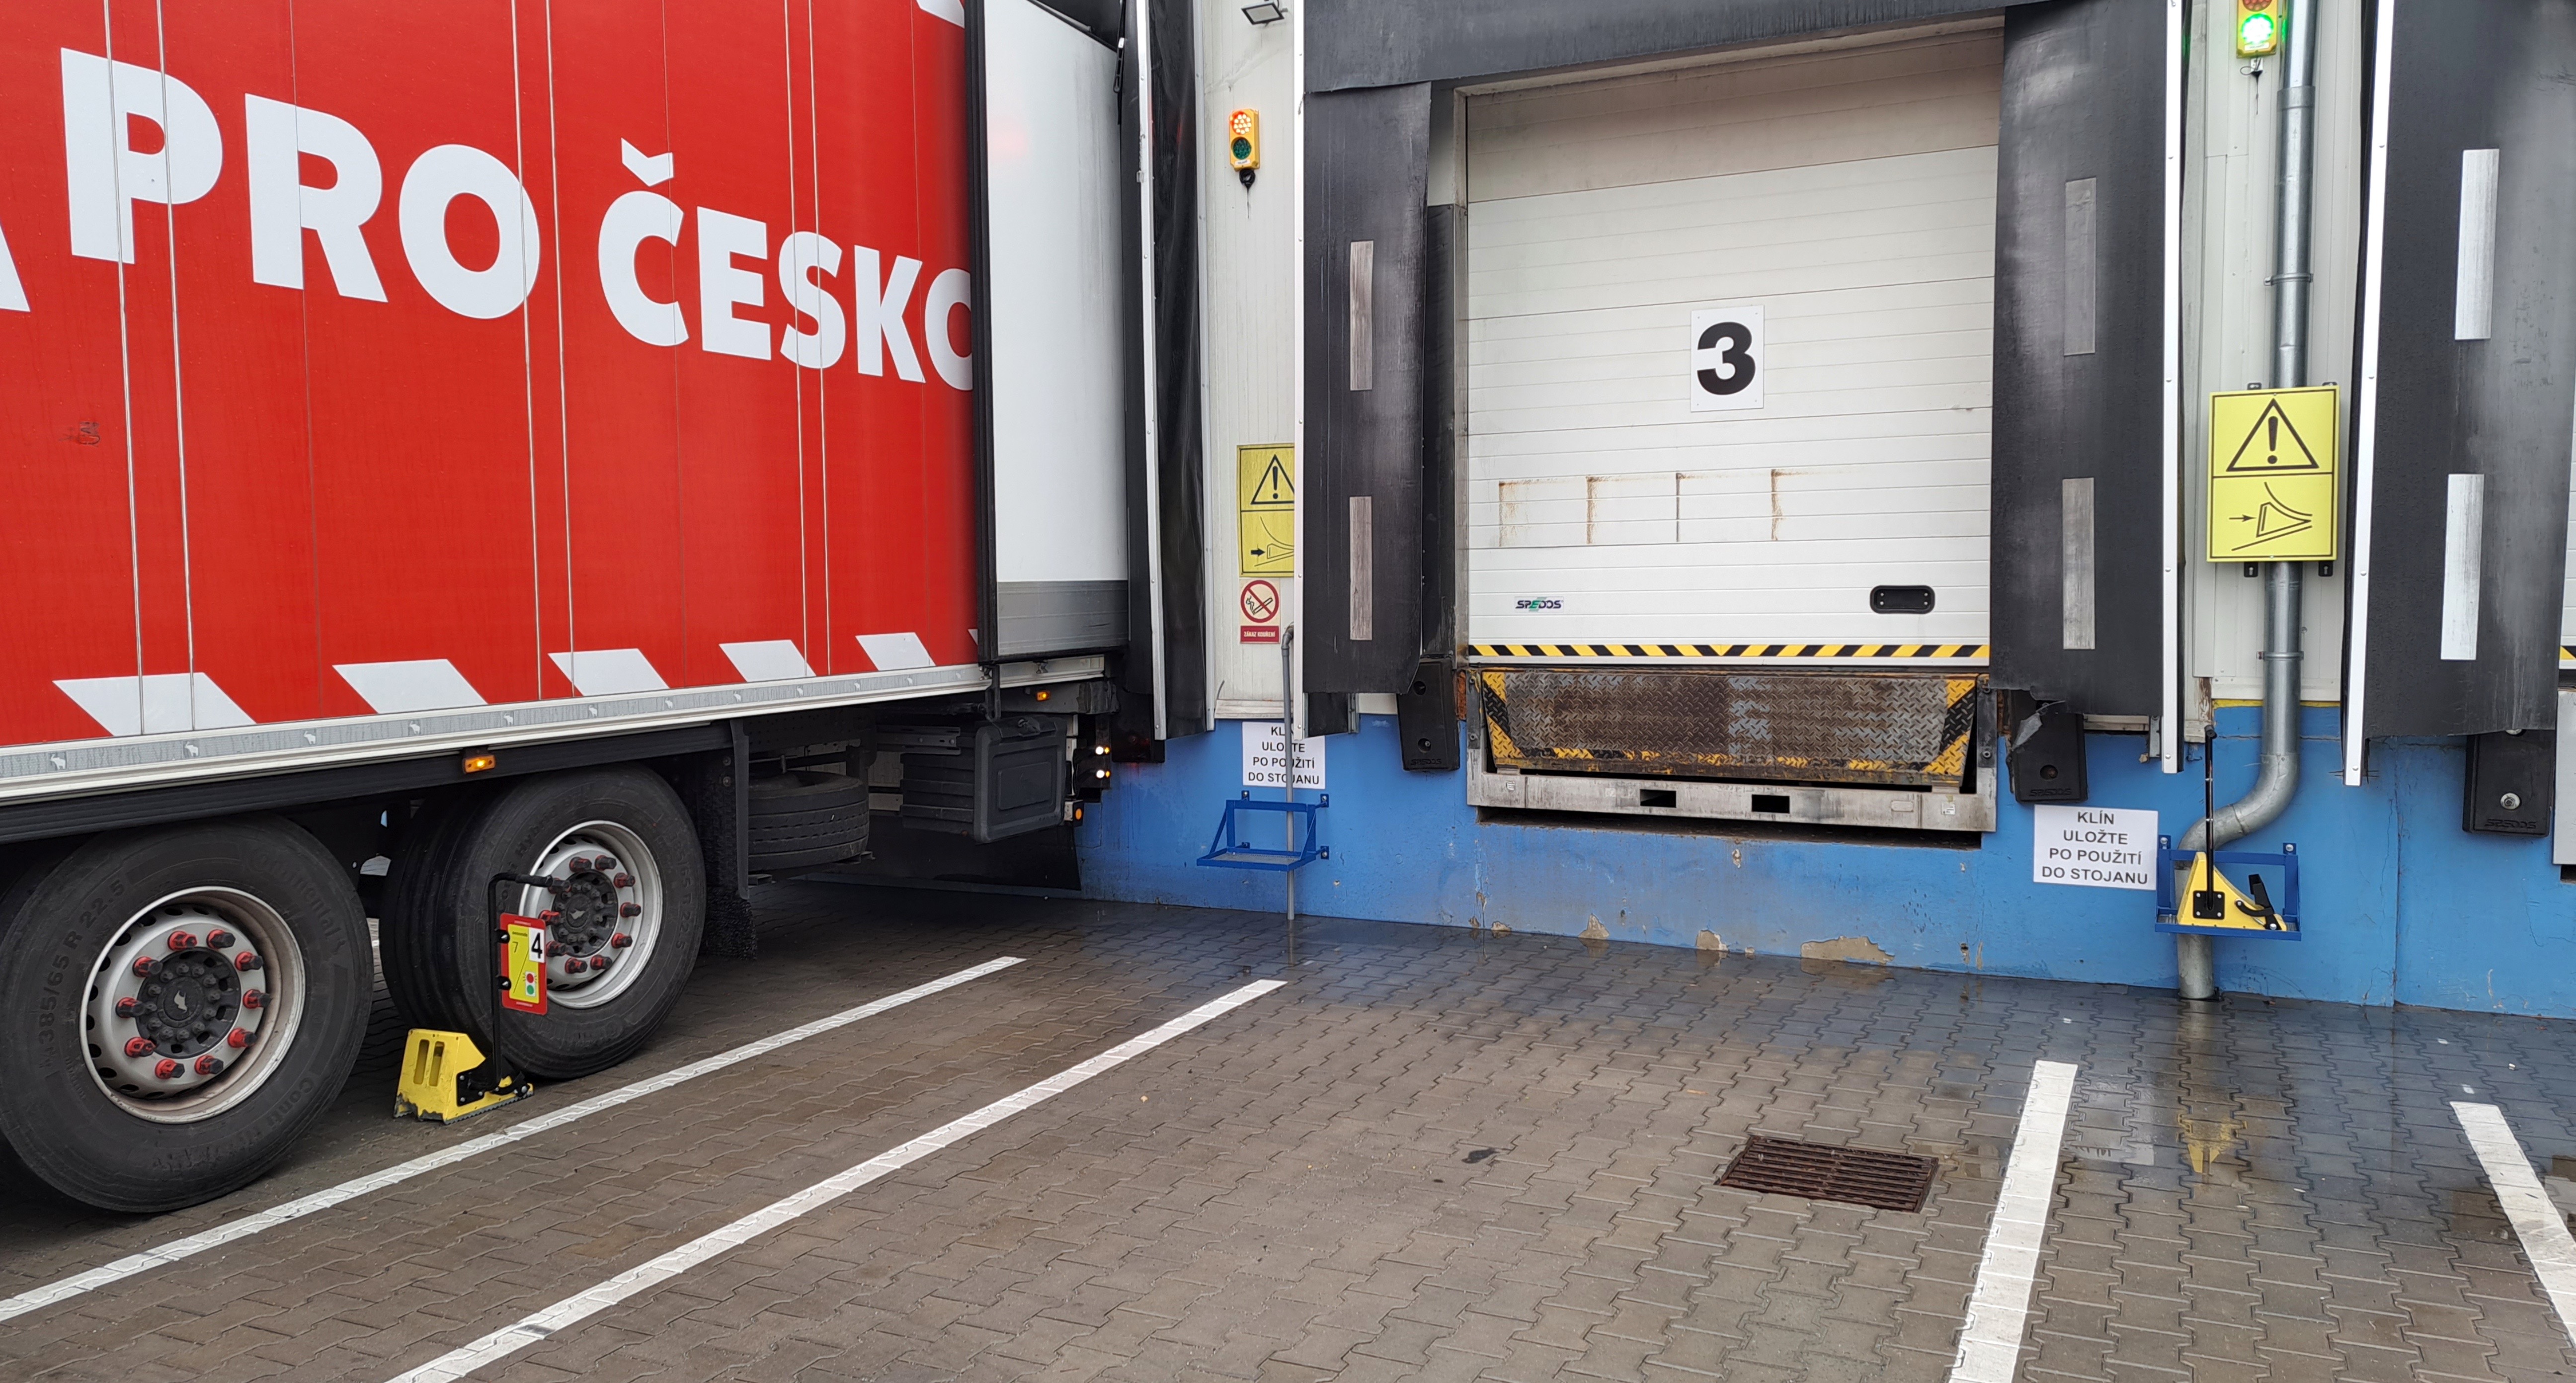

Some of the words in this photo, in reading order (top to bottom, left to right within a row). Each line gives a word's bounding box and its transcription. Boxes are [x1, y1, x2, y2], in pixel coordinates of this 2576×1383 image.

[61, 47, 540, 320] PRO
[598, 138, 972, 391] ČESKO
[1697, 322, 1756, 395] 3
[1516, 599, 1562, 610] SPEDOS
[1271, 727, 1293, 736] KL
[1262, 741, 1305, 752] ULOTE
[1253, 757, 1268, 766] PO
[1272, 757, 1314, 769] POŽITÍ
[1248, 772, 1264, 782] DO
[2078, 811, 2114, 824] KLÍN
[2064, 829, 2128, 845] ULOŽTE
[2050, 848, 2072, 860] PO
[2078, 849, 2142, 865] POUŽITÍ
[2042, 866, 2065, 878] DO
[2071, 868, 2148, 884] STOJANU
[531, 932, 543, 959] 4
